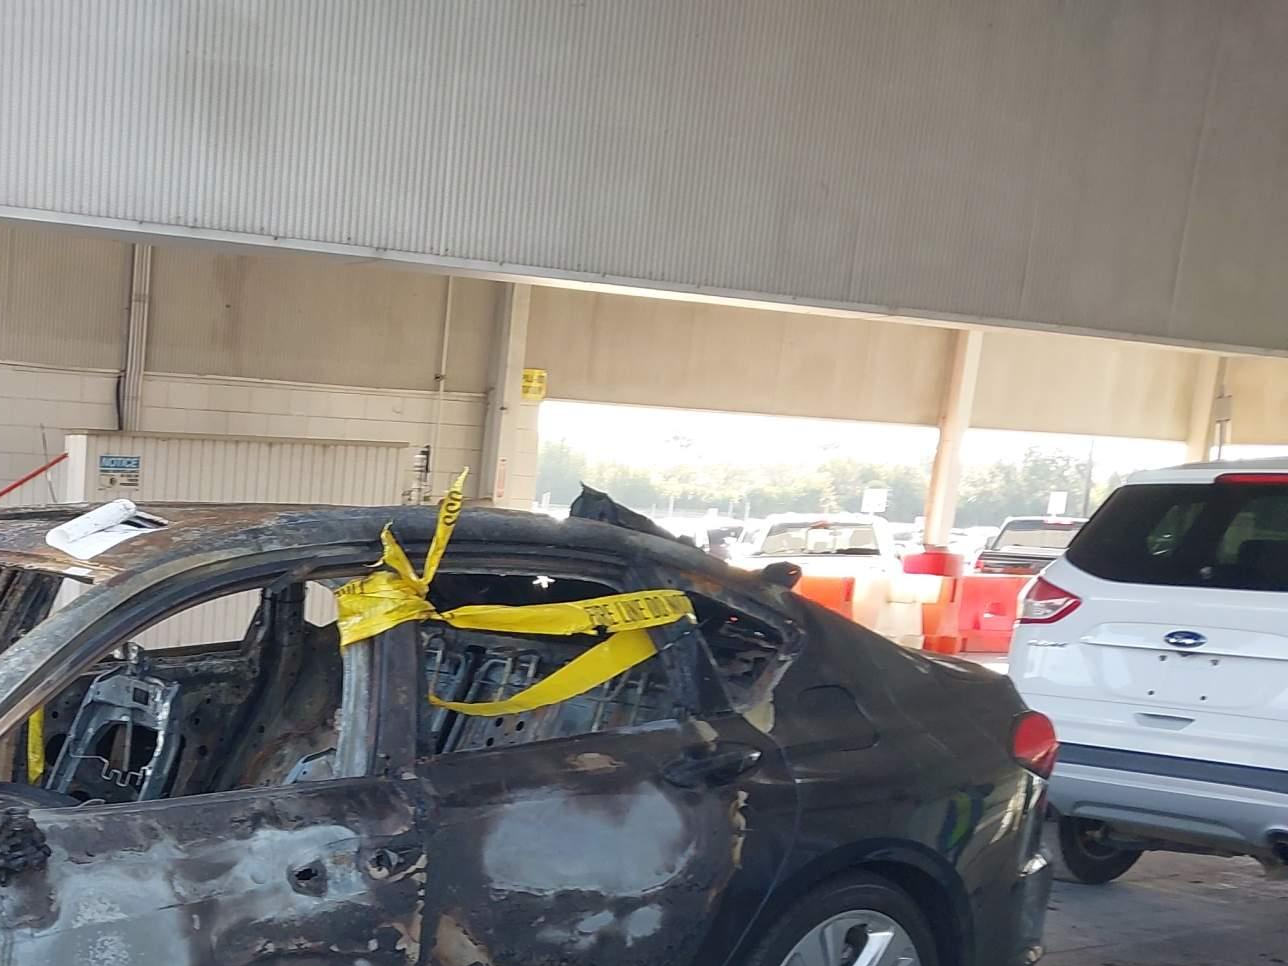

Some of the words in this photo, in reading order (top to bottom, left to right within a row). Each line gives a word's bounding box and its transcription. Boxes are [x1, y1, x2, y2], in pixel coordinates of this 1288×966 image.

[583, 603, 619, 626] FIRE
[615, 599, 651, 623] LINE
[644, 596, 669, 619] DO
